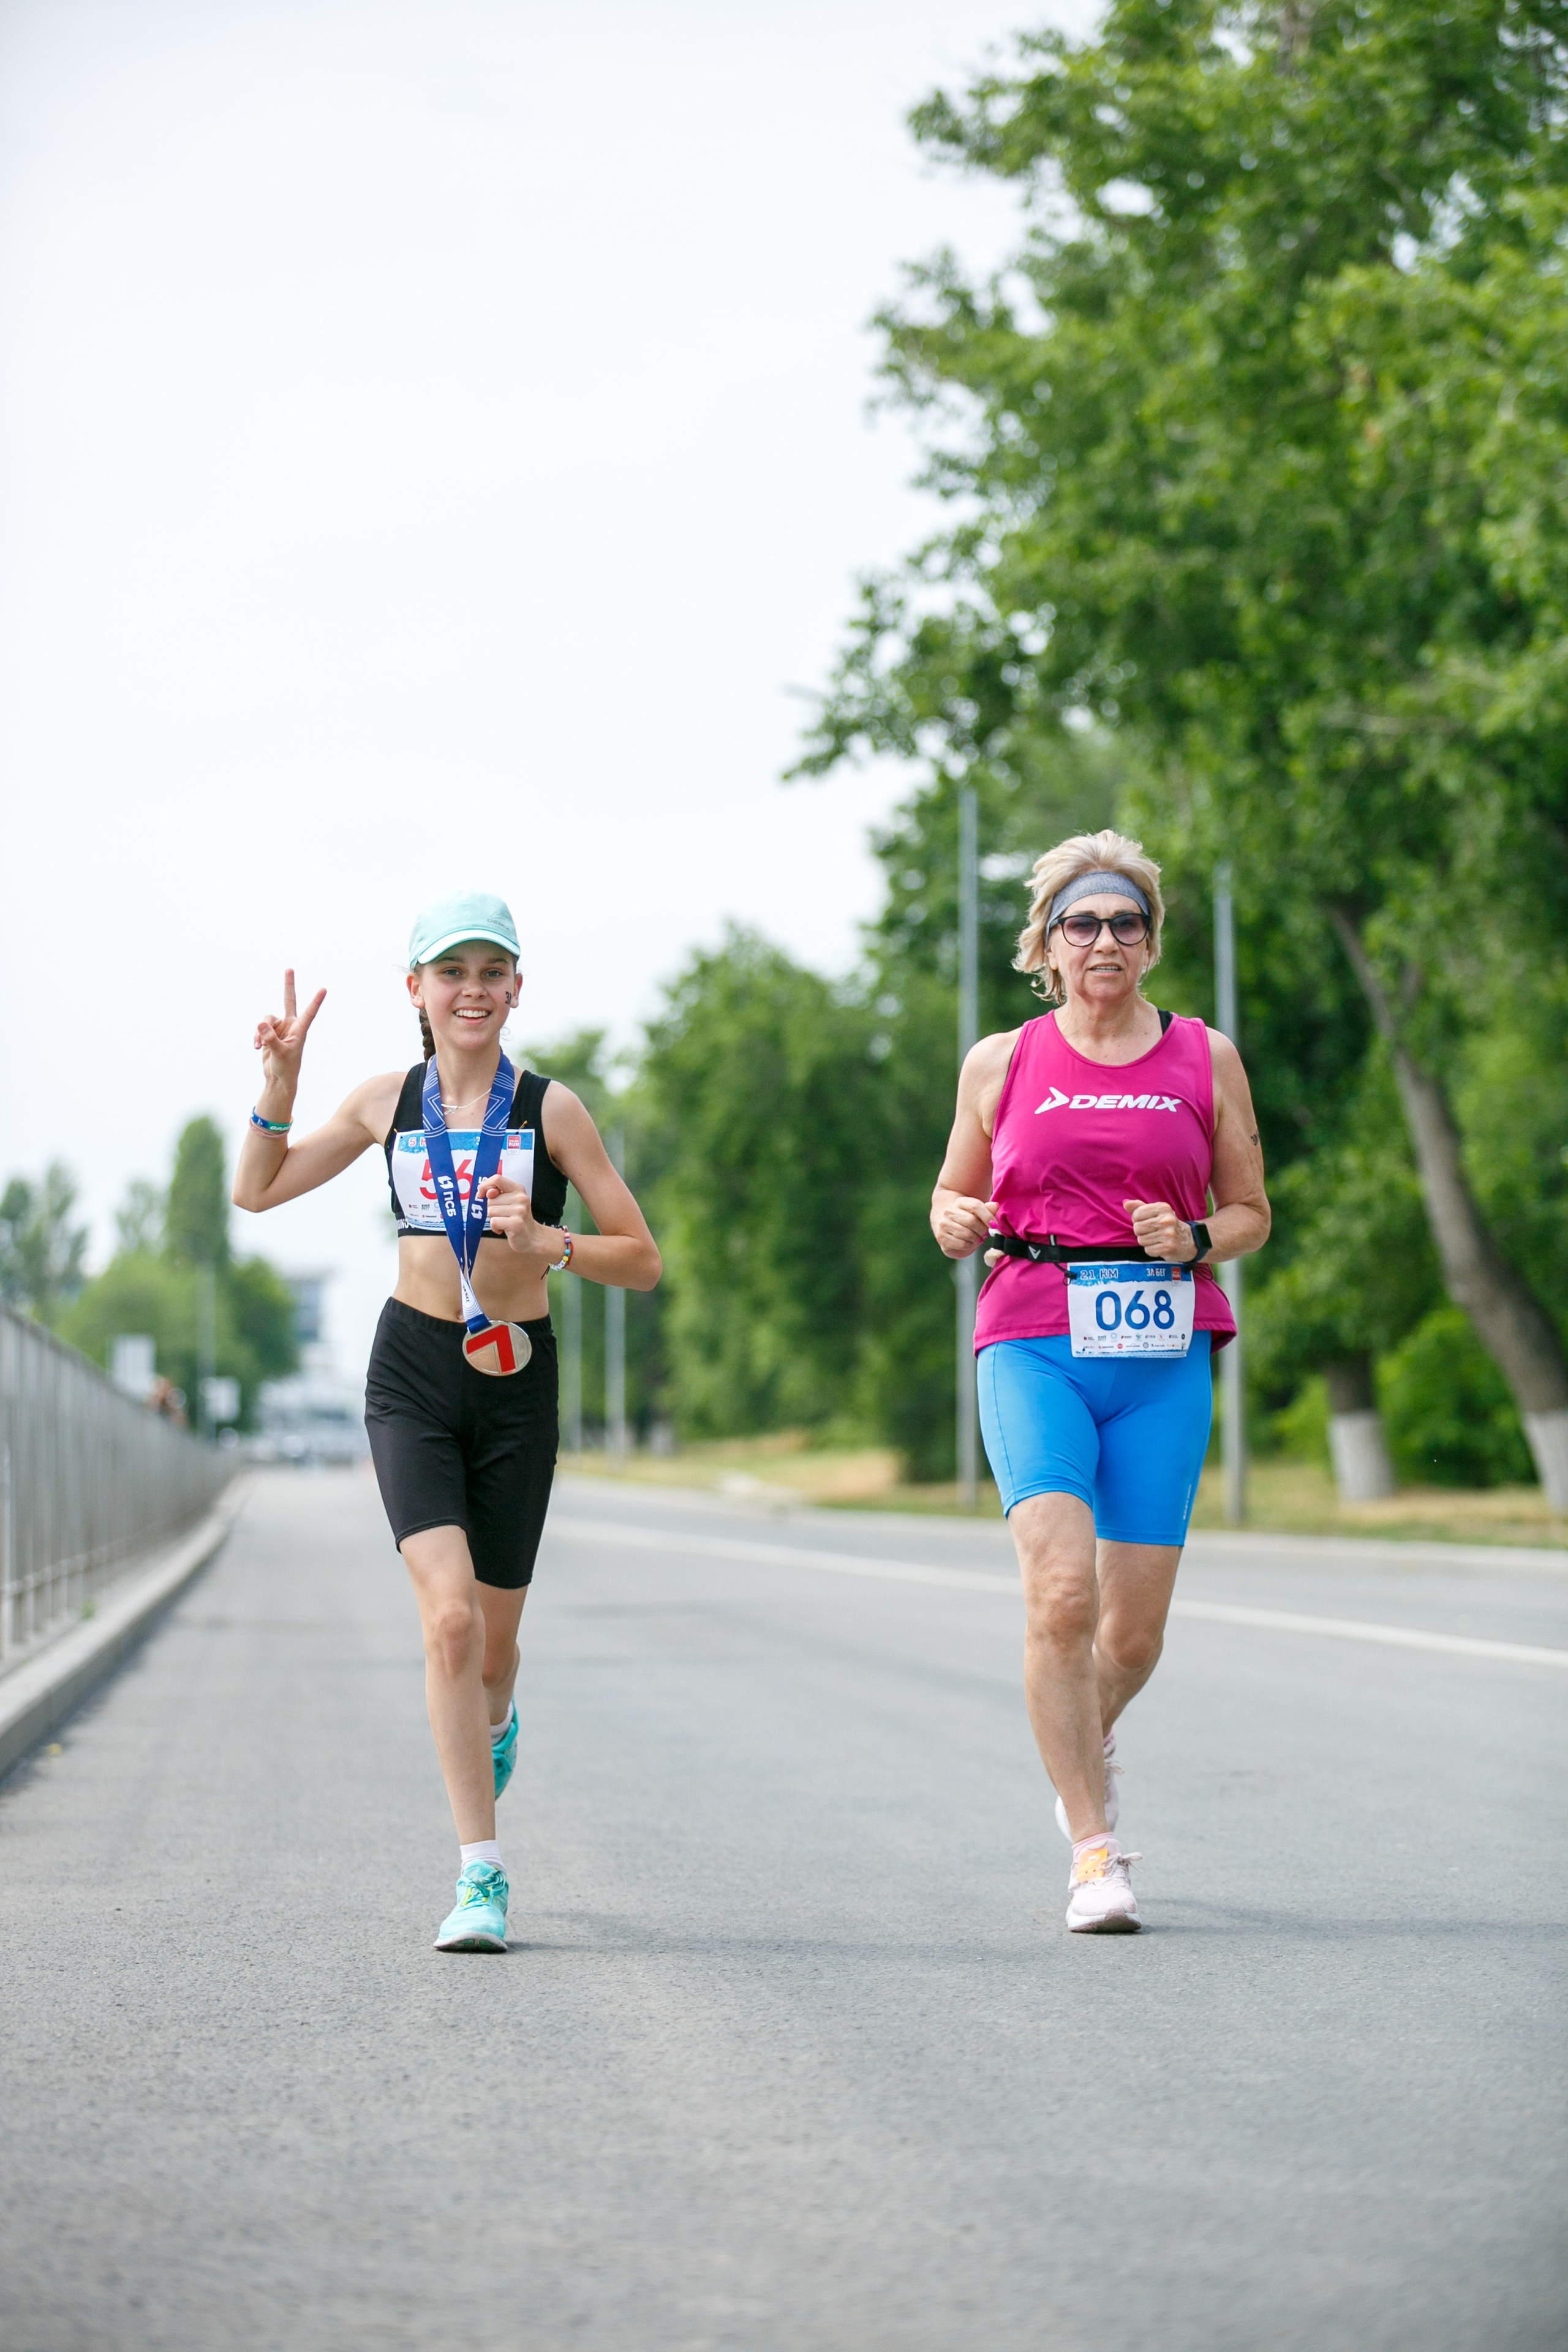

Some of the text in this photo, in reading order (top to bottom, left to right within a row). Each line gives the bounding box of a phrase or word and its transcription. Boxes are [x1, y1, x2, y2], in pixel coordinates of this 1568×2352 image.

[1069, 1095, 1183, 1112] DEMIX
[409, 1137, 417, 1147] 5
[443, 1191, 457, 1217] ПСБ
[1080, 1270, 1096, 1280] 21
[1095, 1289, 1175, 1331] 068
